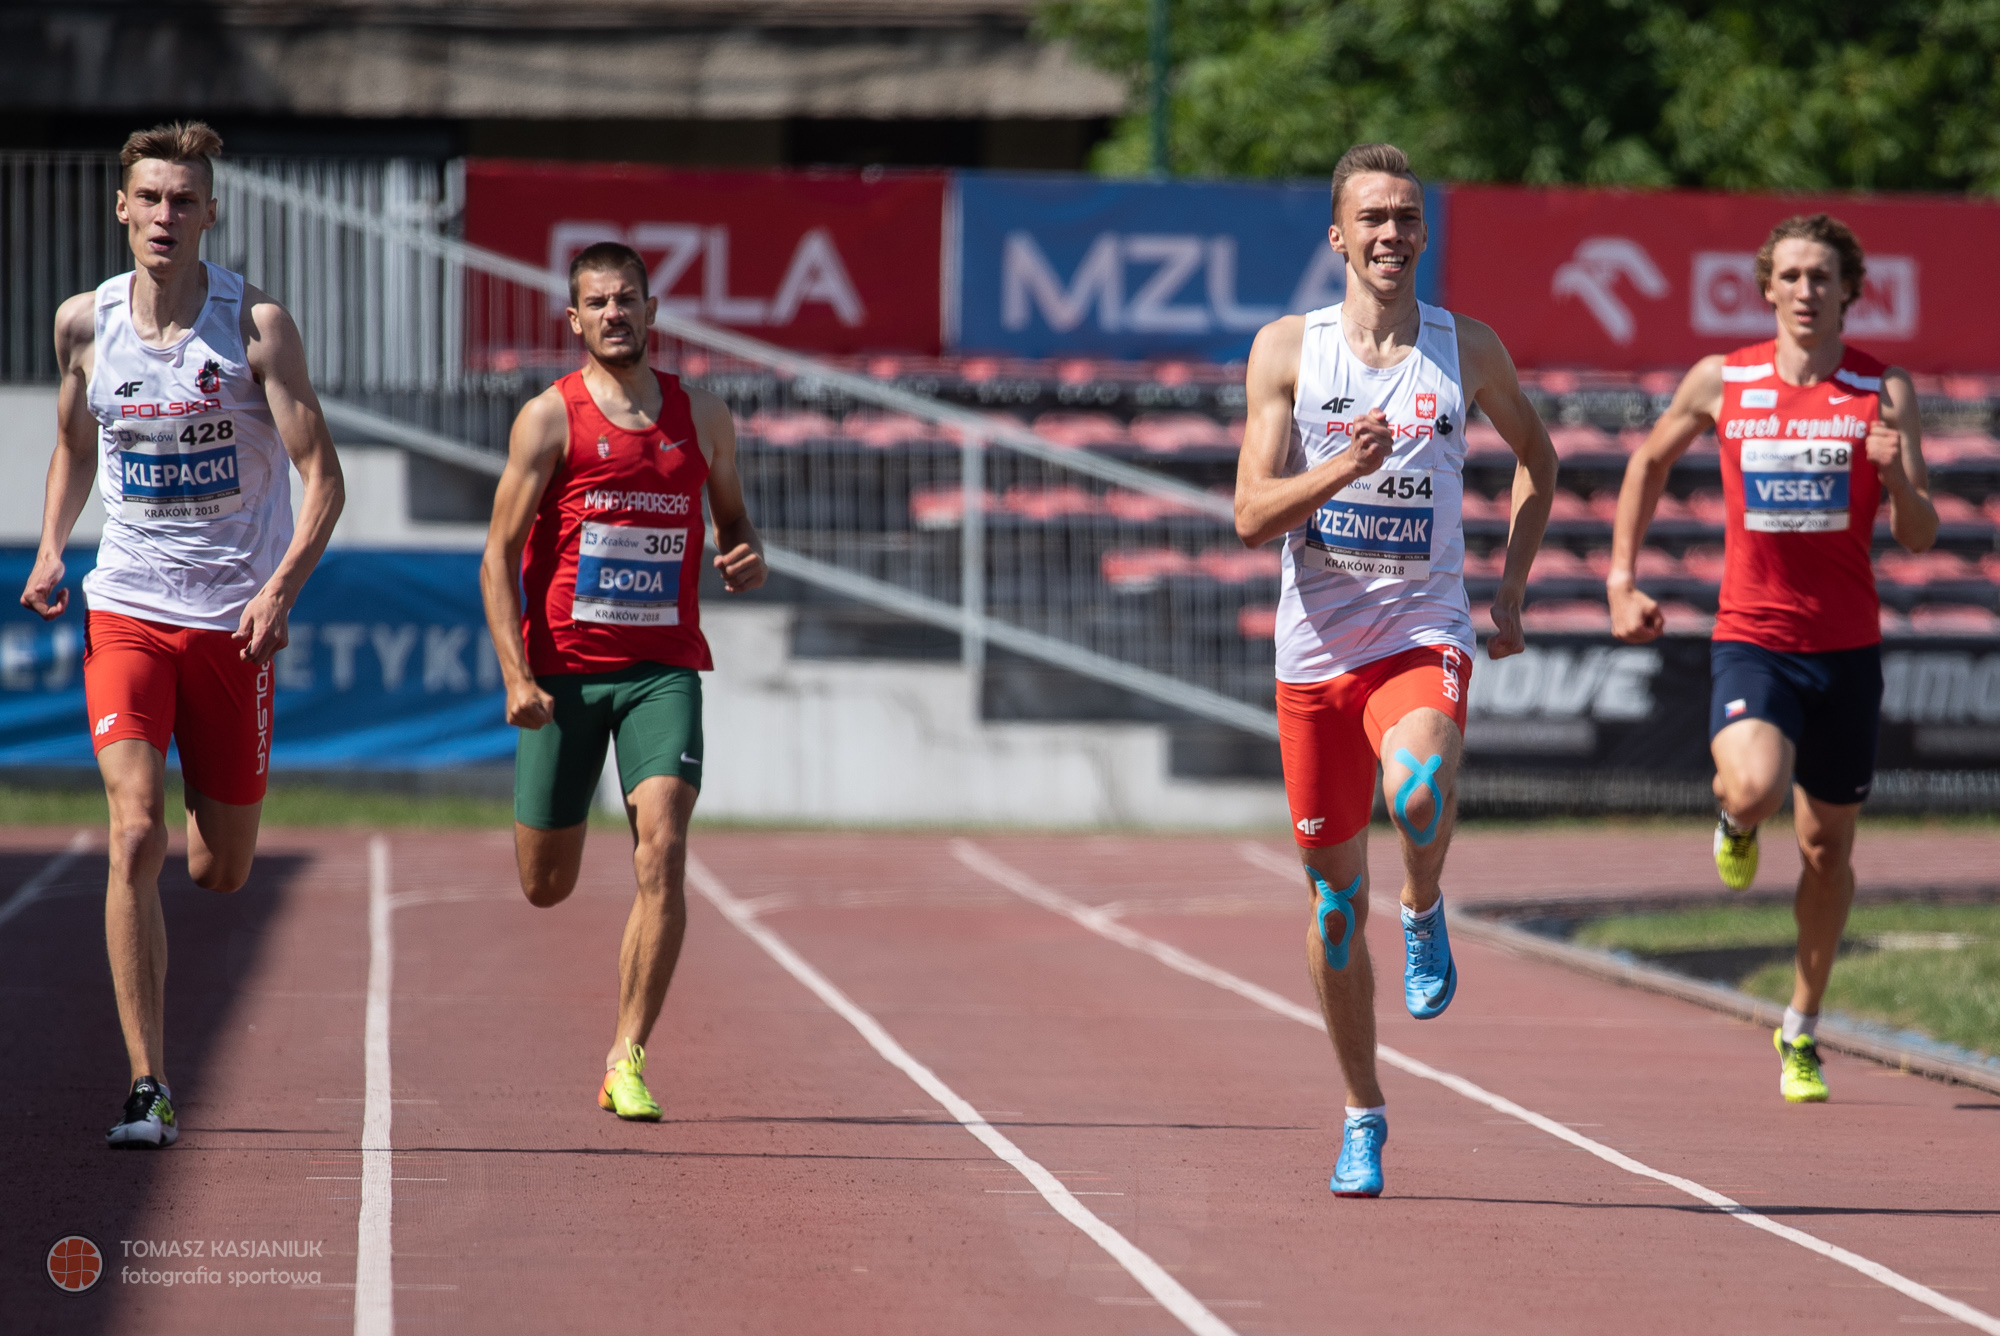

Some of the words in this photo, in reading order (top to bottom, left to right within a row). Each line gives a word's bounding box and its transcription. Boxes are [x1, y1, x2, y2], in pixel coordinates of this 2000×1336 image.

[114, 381, 144, 397] 4F
[121, 398, 222, 418] POLSKA
[1321, 397, 1355, 413] 4F
[134, 432, 174, 443] Kraków
[179, 420, 234, 446] 428
[1326, 421, 1434, 440] PKA
[1785, 414, 1867, 440] republic
[1804, 448, 1848, 465] 158
[125, 455, 236, 487] KLEPACKI
[1377, 476, 1433, 499] 454
[1755, 475, 1835, 502] VESELÝ
[144, 507, 192, 518] KRAKÓW
[195, 504, 220, 516] 2018
[584, 489, 691, 515] MAGYARORSZÁG
[1311, 508, 1429, 543] RZEŹNICZAK
[601, 536, 640, 548] Kraków
[644, 534, 684, 555] 305
[1324, 557, 1375, 573] KRAKÓW
[1378, 564, 1405, 575] 2018
[599, 567, 663, 593] BODA
[594, 609, 639, 622] KRAKÓW
[95, 713, 118, 736] 4F
[1297, 817, 1325, 834] 4F
